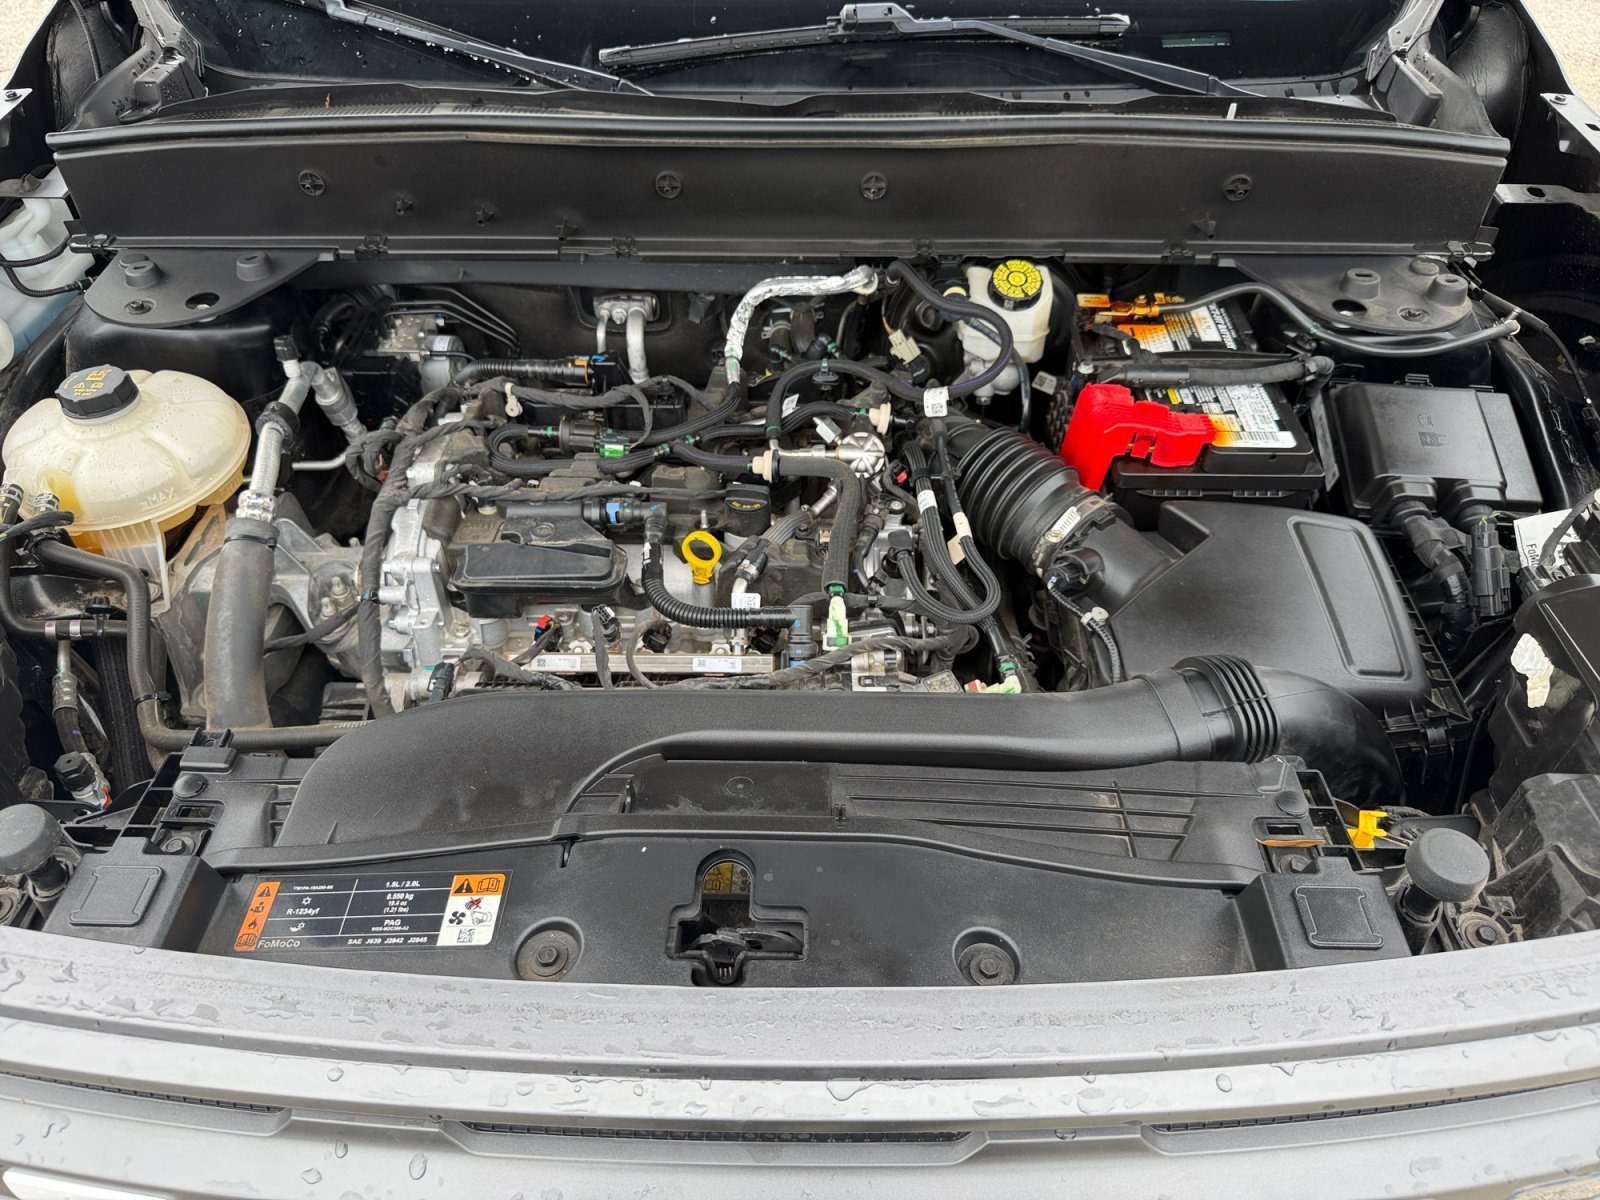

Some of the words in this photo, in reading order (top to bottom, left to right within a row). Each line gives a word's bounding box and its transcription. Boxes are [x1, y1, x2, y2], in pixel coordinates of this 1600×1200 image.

[147, 487, 175, 505] MAX
[401, 880, 406, 888] /
[404, 892, 414, 901] kg
[286, 907, 321, 916] R-1234yf
[257, 939, 301, 948] FoMoCo
